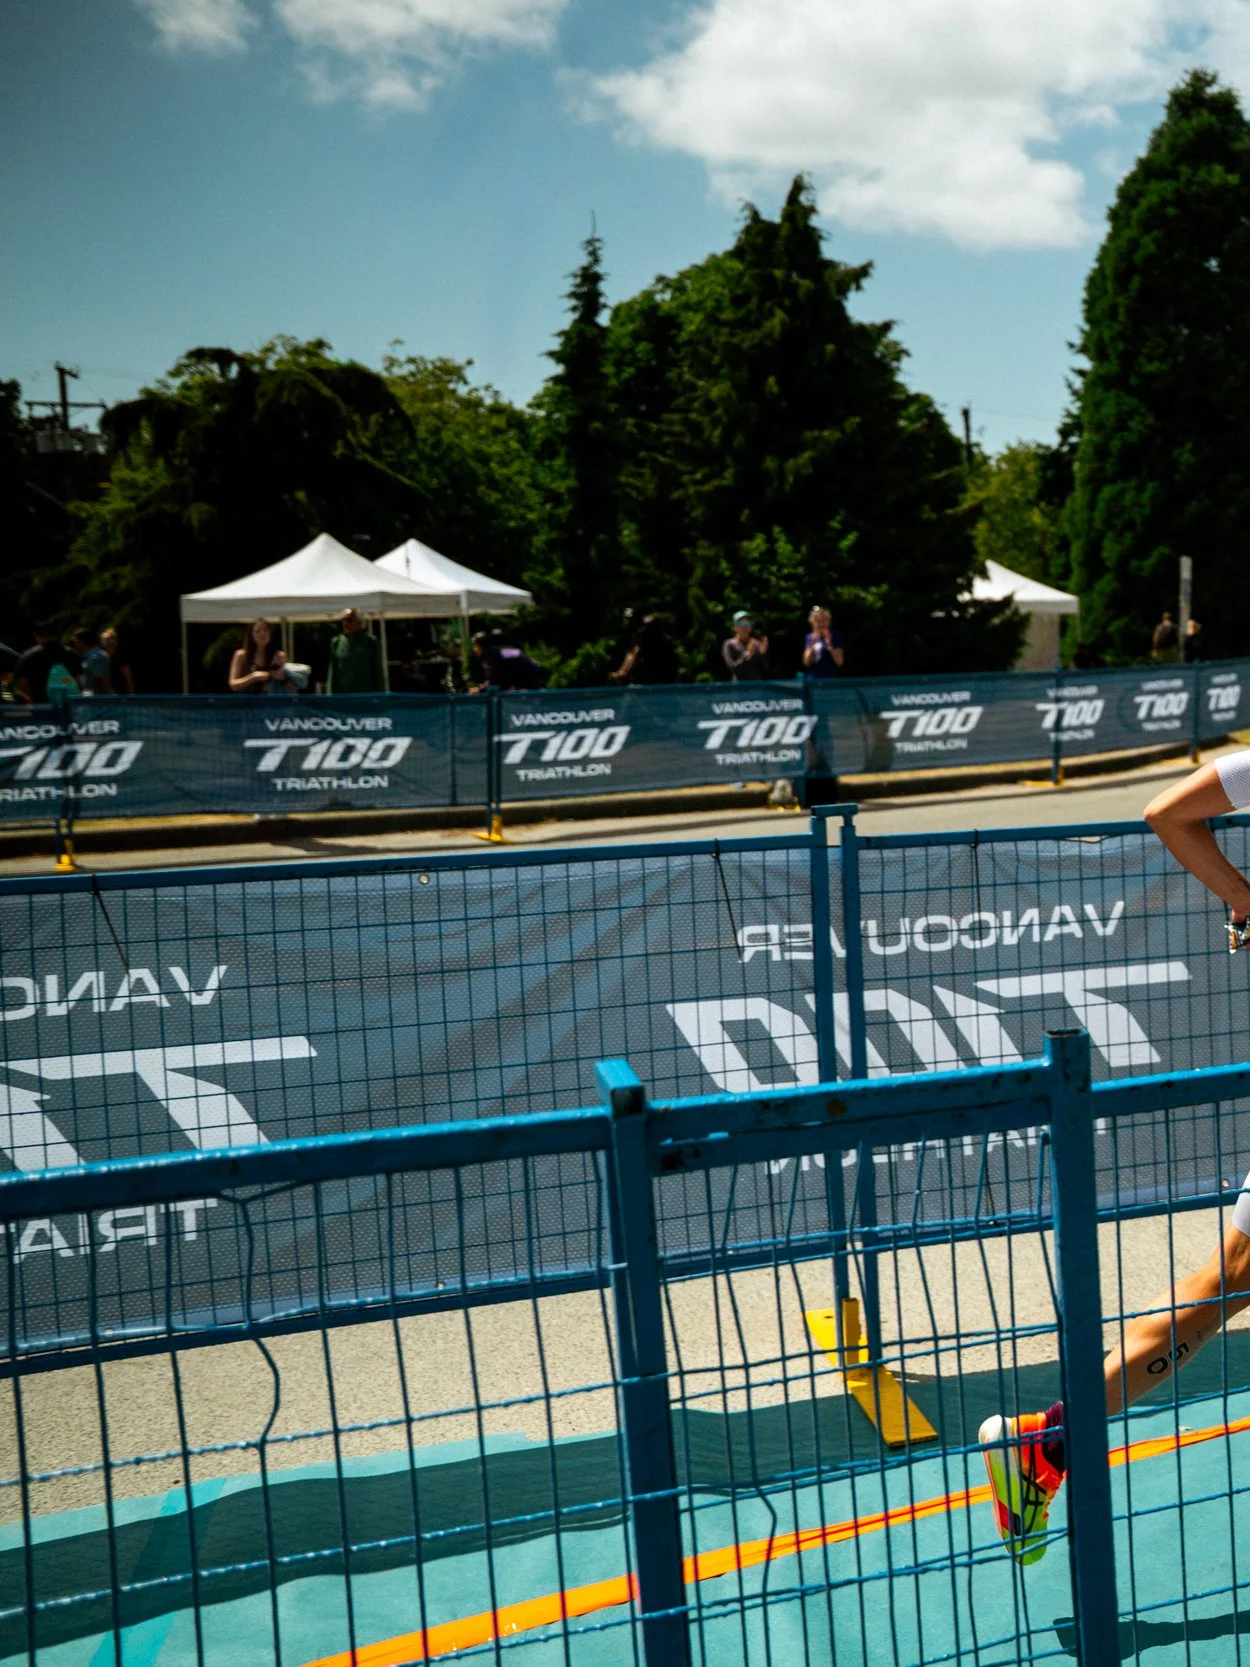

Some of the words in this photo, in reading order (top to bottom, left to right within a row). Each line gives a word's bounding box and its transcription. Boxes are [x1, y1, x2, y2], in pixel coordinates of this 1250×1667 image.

[711, 698, 803, 714] VANCOUVER
[890, 690, 971, 706] VANCOUVER
[1133, 691, 1189, 720] T100
[510, 708, 616, 727] VANCOUVER
[880, 706, 984, 738] T100
[1035, 699, 1105, 729] T100
[265, 717, 393, 732] VANCOUVER
[697, 714, 819, 750] T100
[243, 736, 413, 773] T100
[492, 725, 632, 765] T100
[894, 738, 968, 754] TRIATHLON
[714, 749, 802, 765] TRIATHLON
[515, 763, 612, 782] TRIATHLON
[272, 775, 389, 791] TRIATHLON
